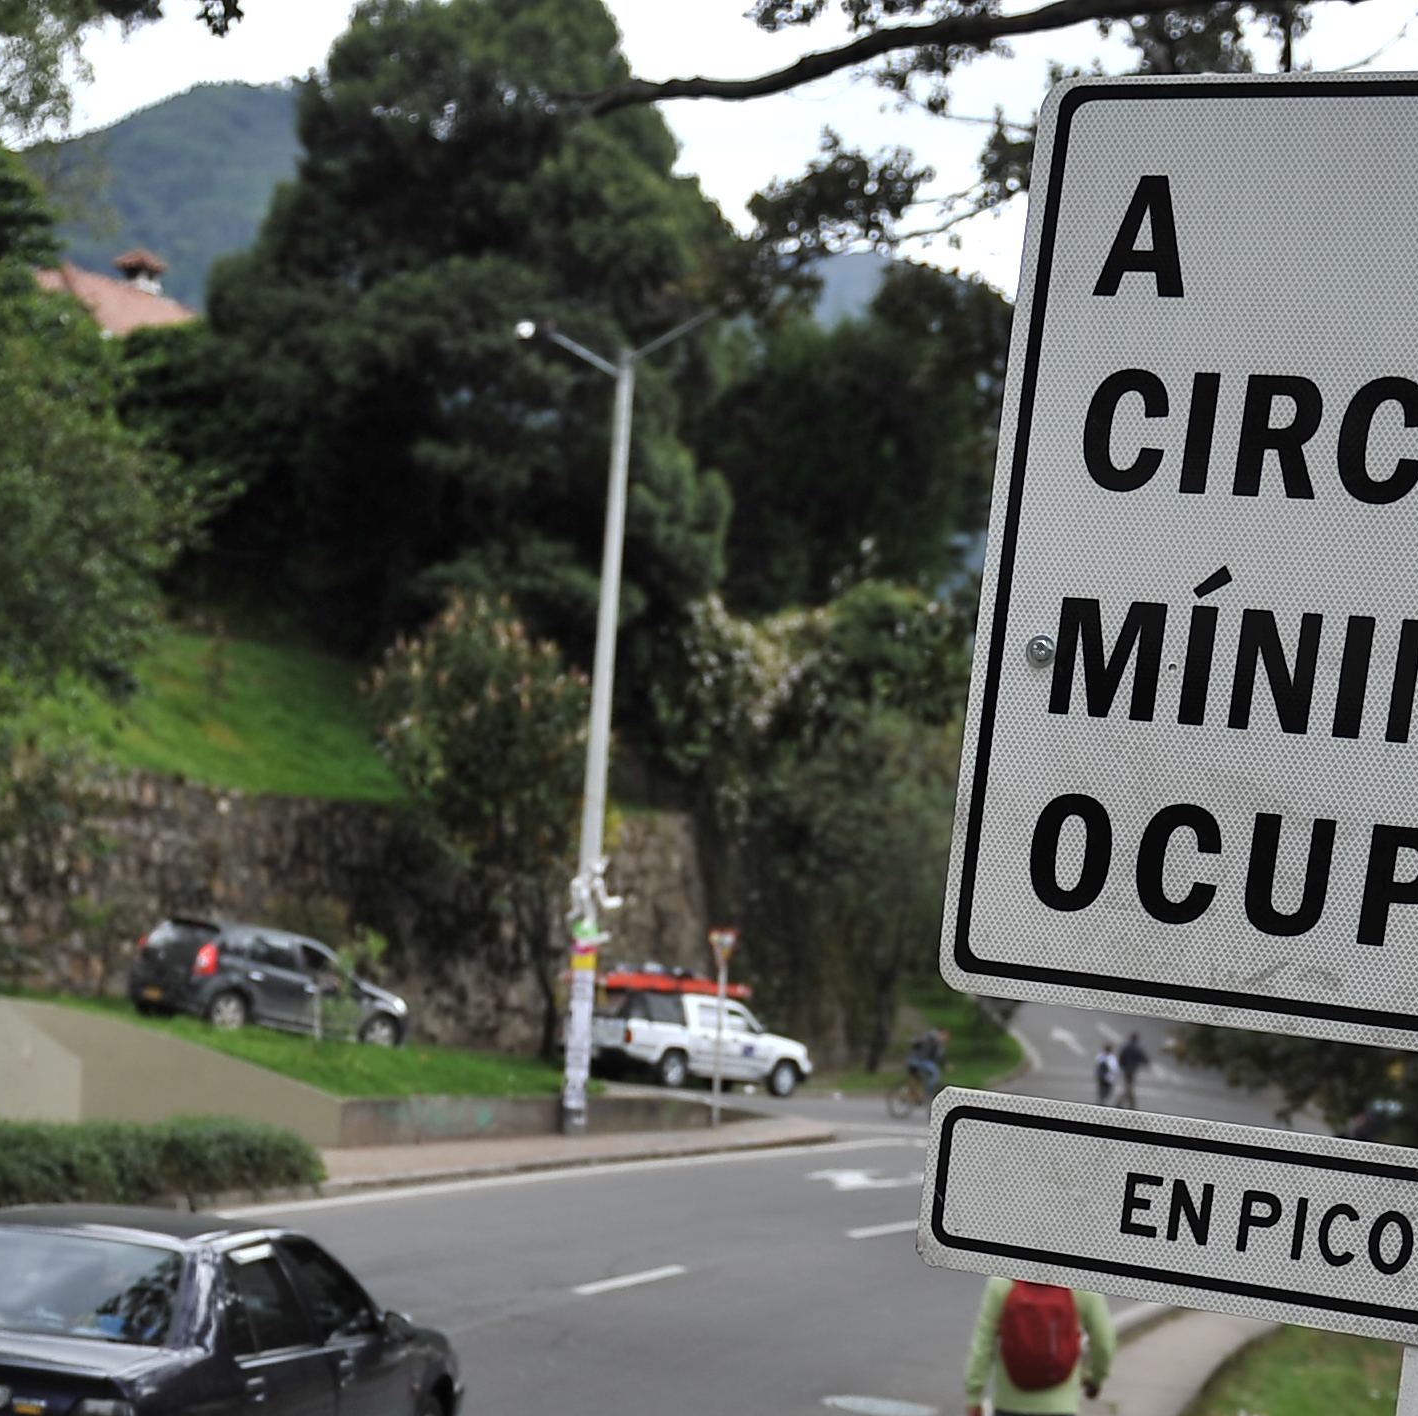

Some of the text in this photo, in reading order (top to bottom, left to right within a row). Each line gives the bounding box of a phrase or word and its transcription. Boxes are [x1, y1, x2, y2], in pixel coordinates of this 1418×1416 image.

[1092, 174, 1185, 299] A
[1118, 1171, 1216, 1247] EN
[1234, 1188, 1415, 1276] PICO
